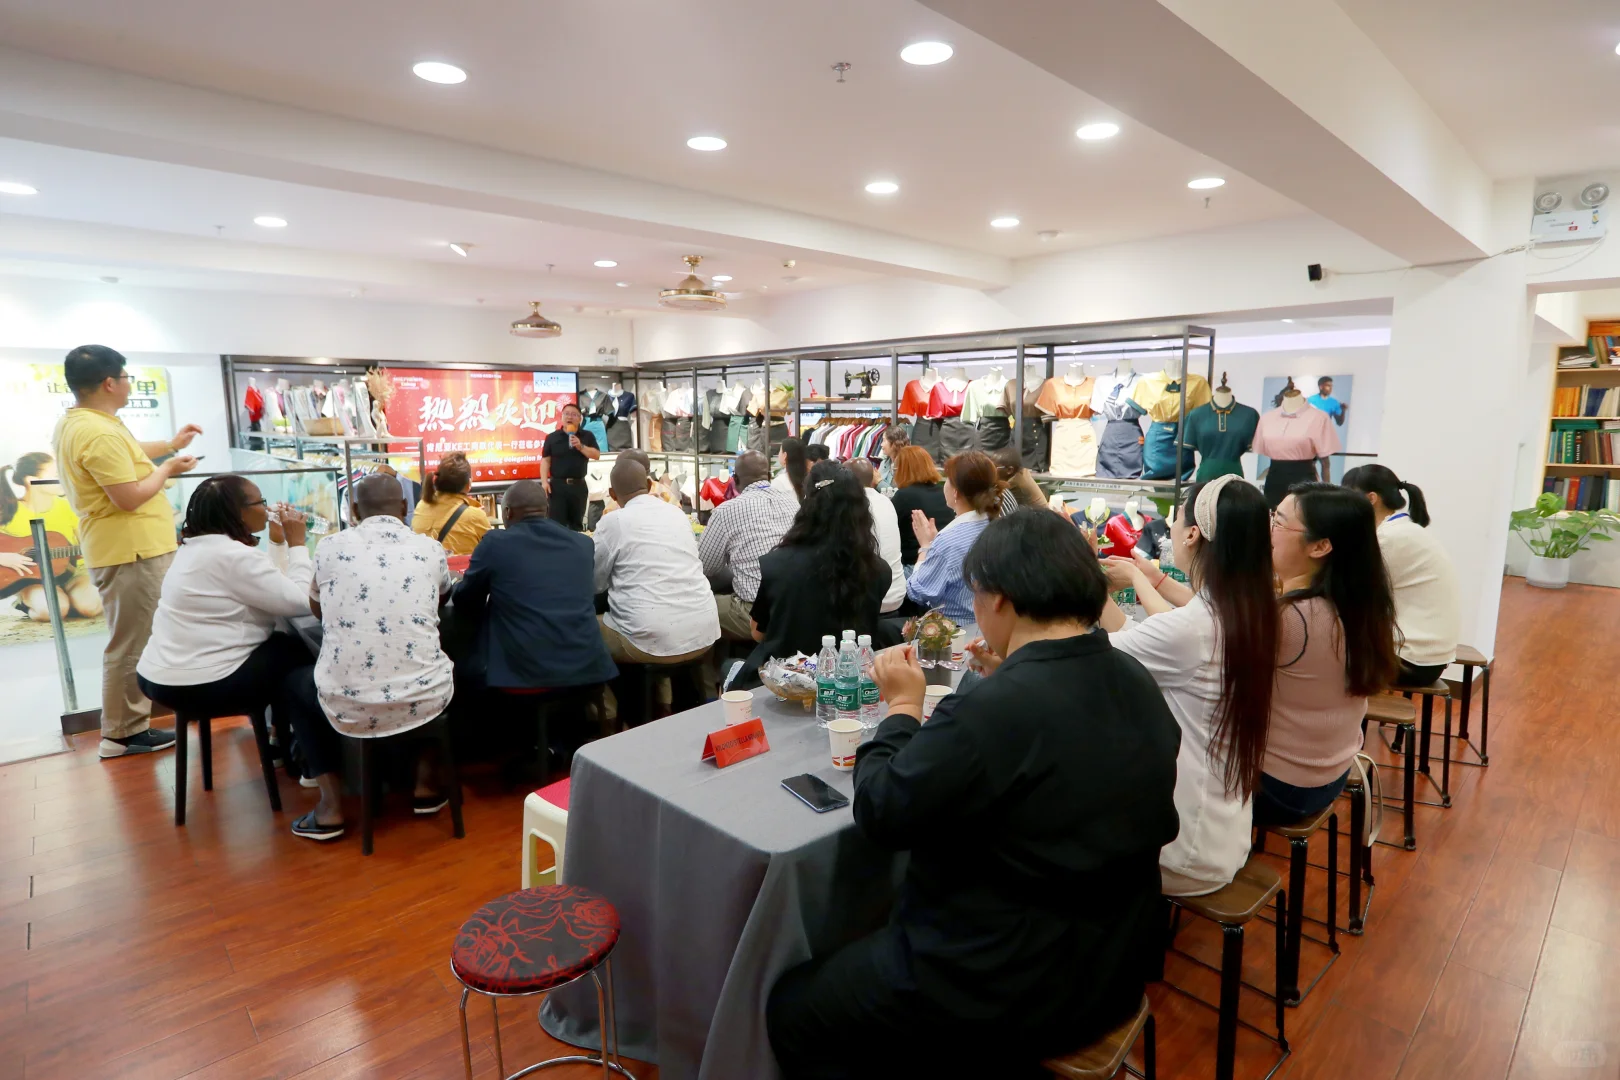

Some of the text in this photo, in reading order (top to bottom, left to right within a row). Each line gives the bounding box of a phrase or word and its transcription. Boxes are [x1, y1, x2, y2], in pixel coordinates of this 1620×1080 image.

[418, 393, 558, 434] 热烈欢迎
[504, 455, 535, 464] delegation
